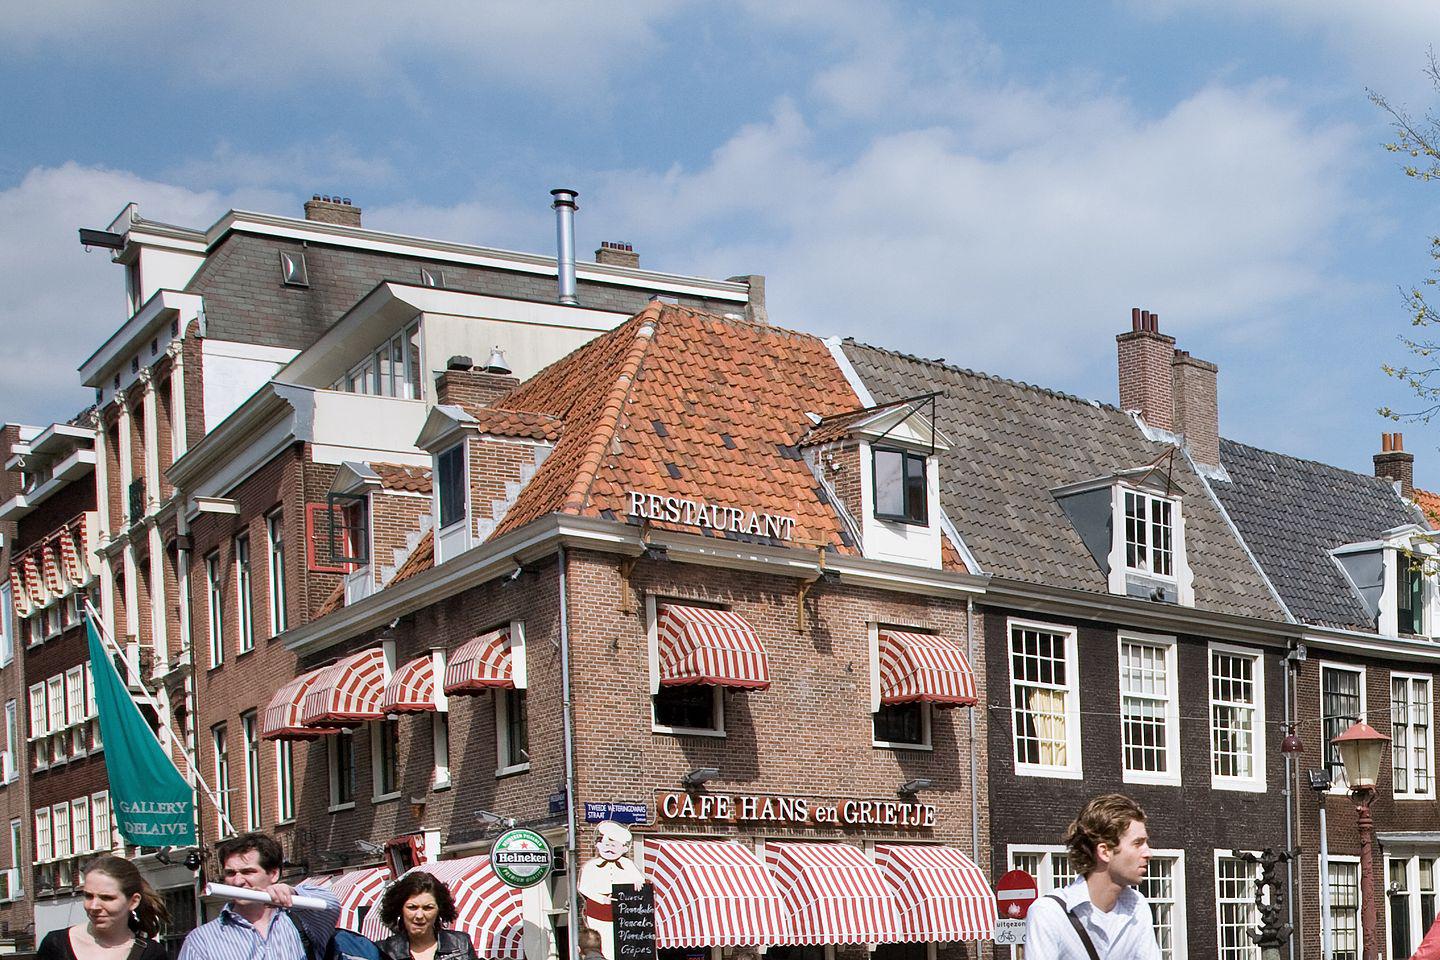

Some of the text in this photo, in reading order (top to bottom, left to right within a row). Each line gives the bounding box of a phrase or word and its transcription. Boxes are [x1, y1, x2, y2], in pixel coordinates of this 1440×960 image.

[629, 491, 795, 541] RESTAURANT
[120, 801, 188, 814] GALLERY
[588, 804, 607, 812] TWEEDE
[663, 794, 936, 827] CAFE HANS en GRIETJE
[124, 821, 188, 836] DELAIVE
[499, 853, 547, 863] Heineken
